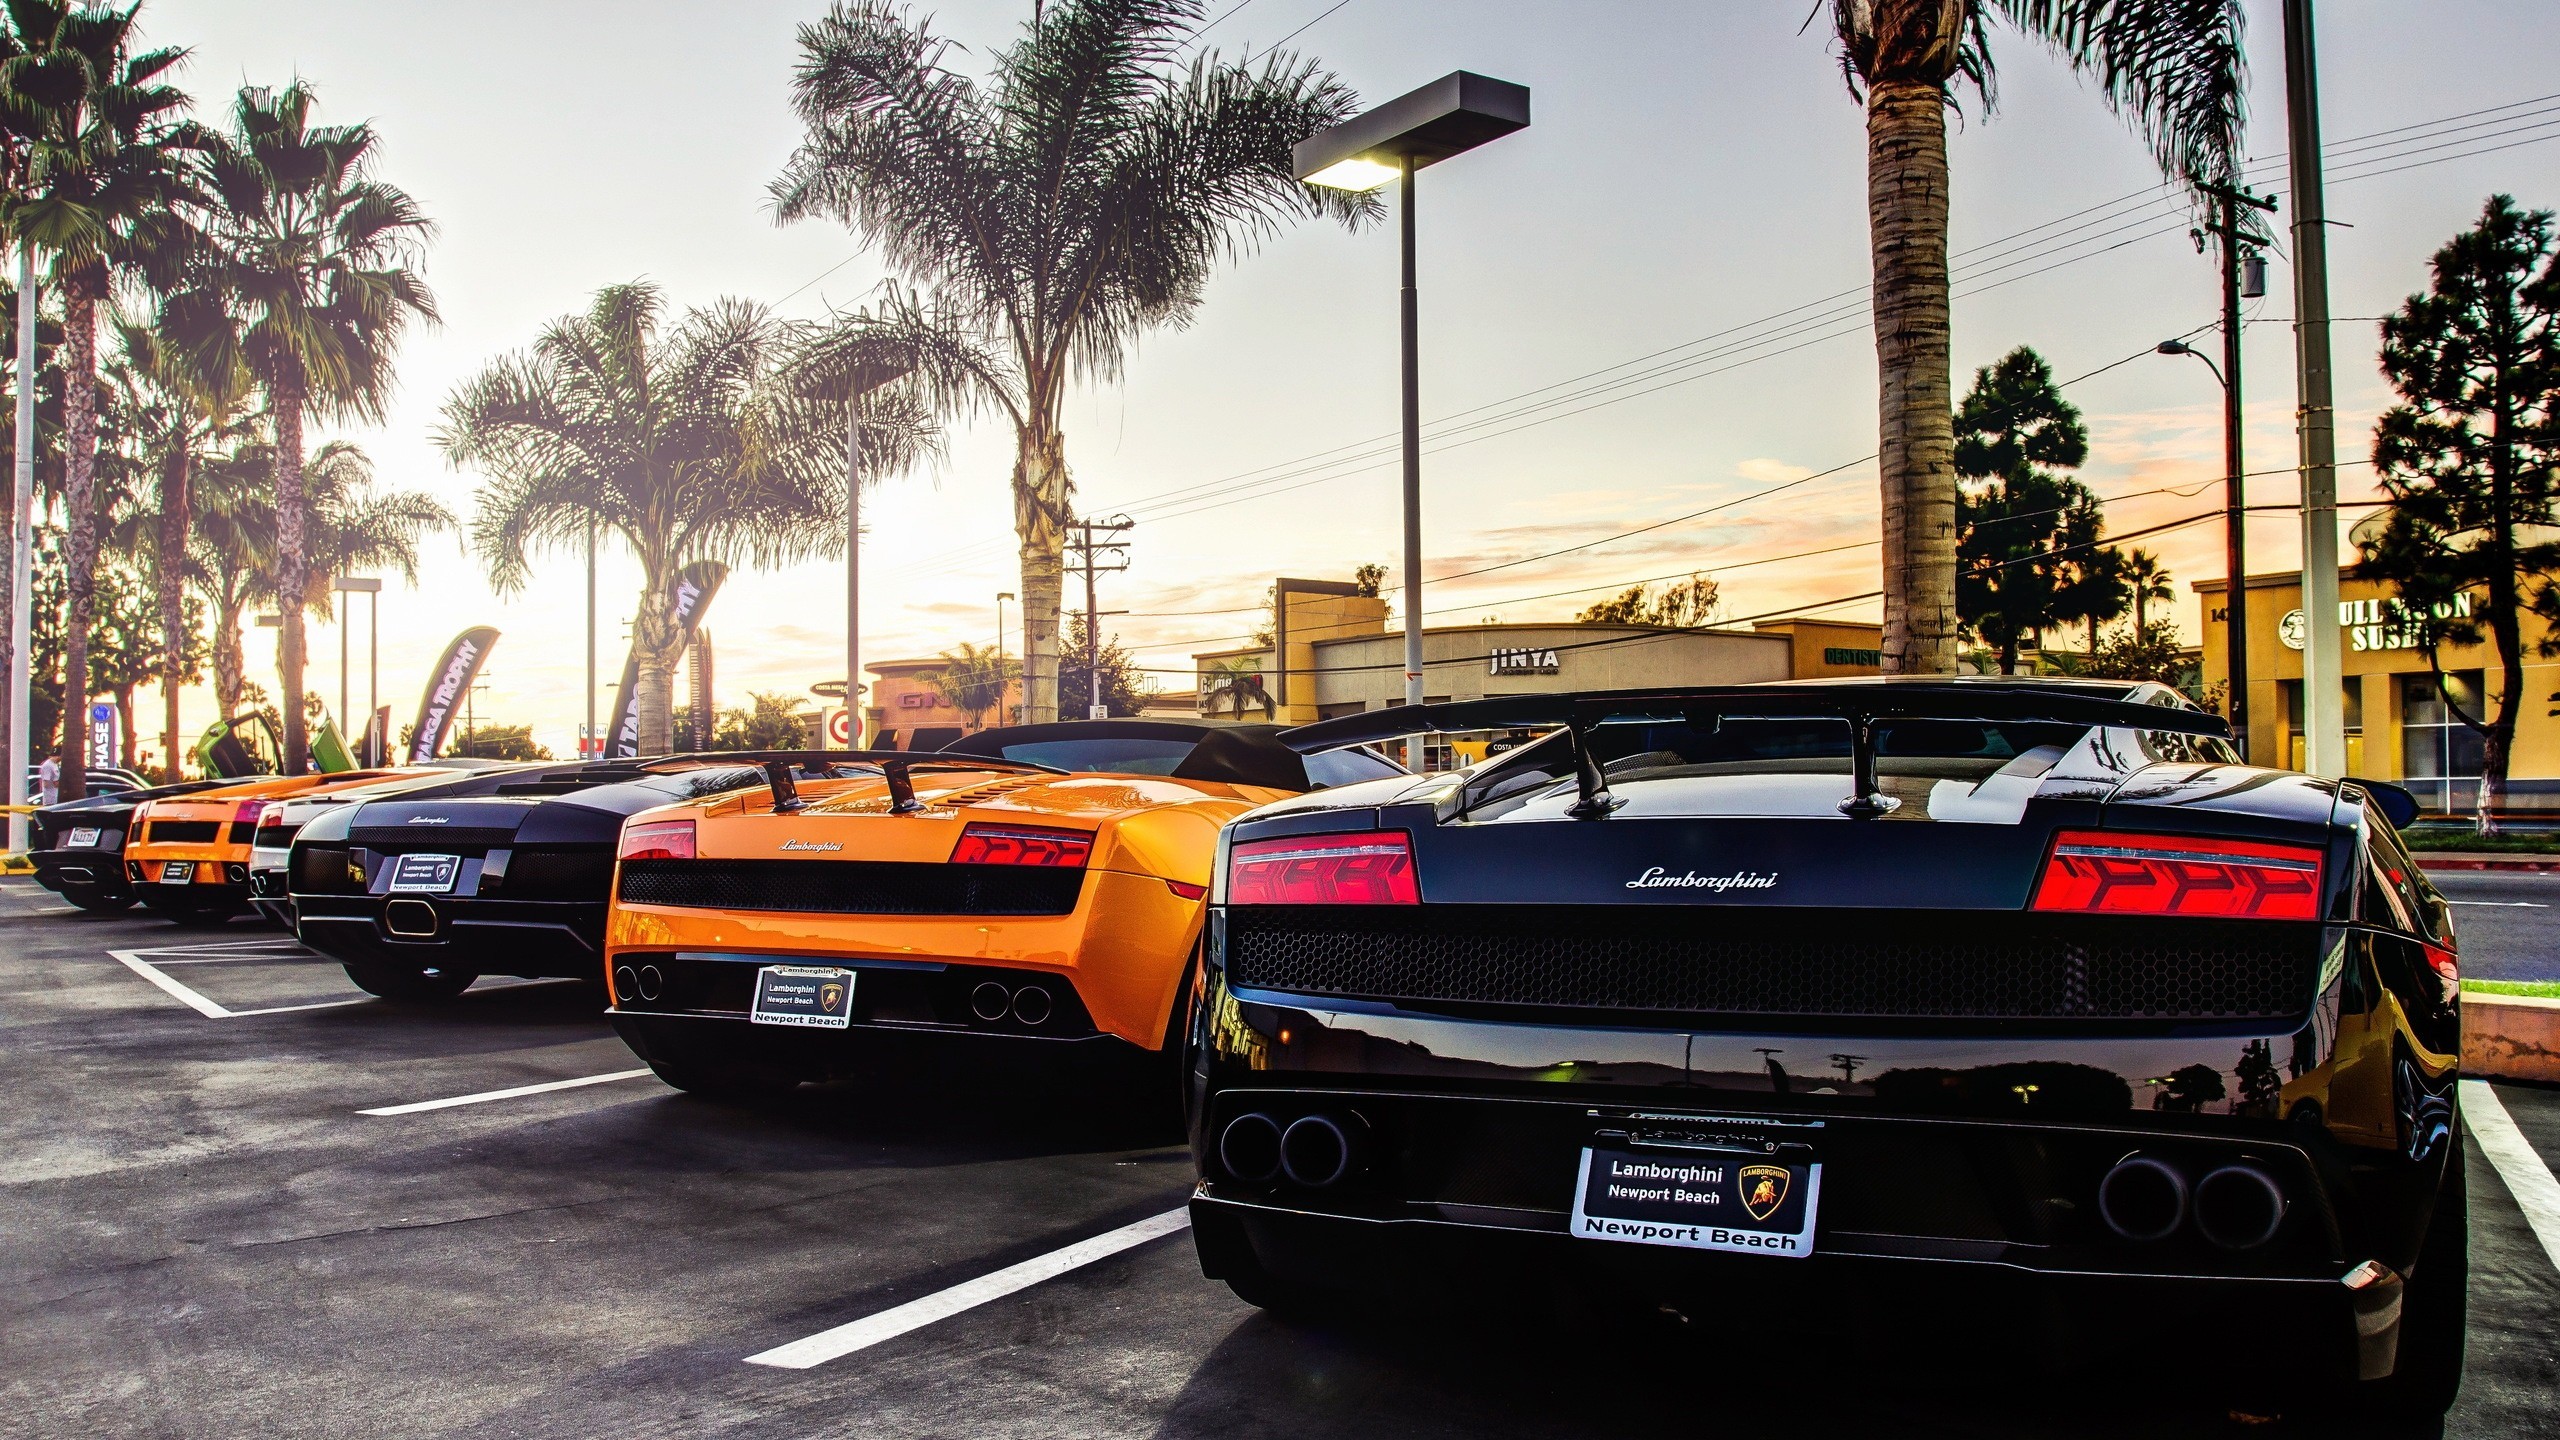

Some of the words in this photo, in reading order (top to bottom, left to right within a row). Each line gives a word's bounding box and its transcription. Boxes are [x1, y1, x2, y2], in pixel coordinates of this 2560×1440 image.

[2338, 598, 2384, 626] ULL
[1490, 647, 1559, 675] JINYA
[432, 639, 479, 706] TROPHY
[898, 692, 951, 708] GN
[1493, 743, 1513, 751] COSTA
[779, 839, 844, 853] Lamborghini
[1625, 866, 1779, 893] Lamborghini
[782, 966, 834, 975] Lamborghini
[768, 983, 816, 995] Lamborghini
[767, 995, 793, 1005] Newport
[794, 997, 814, 1005] Beach
[754, 1013, 804, 1024] Newport
[808, 1016, 845, 1026] Beach
[1611, 1160, 1723, 1183] Lamborghini
[1743, 1168, 1787, 1180] LAMBORGHINI
[1608, 1184, 1670, 1201] Newport
[1674, 1189, 1720, 1205] Beach
[1584, 1218, 1700, 1242] Newport
[1710, 1229, 1797, 1250] Beach
